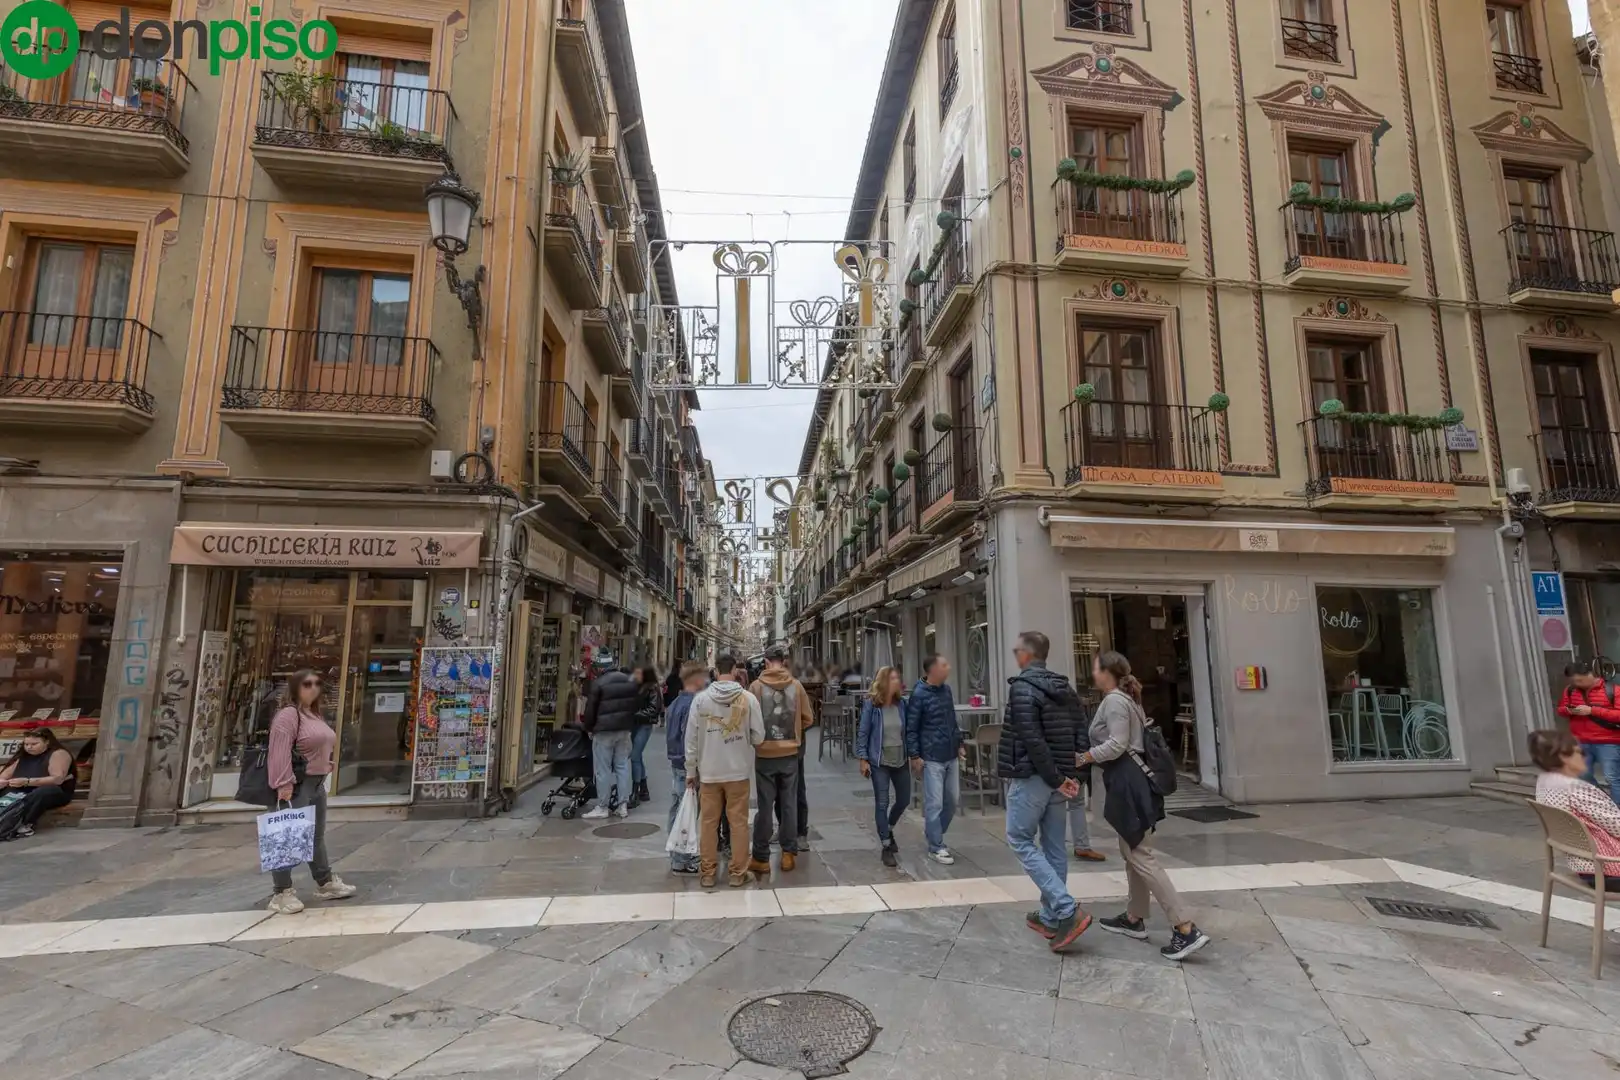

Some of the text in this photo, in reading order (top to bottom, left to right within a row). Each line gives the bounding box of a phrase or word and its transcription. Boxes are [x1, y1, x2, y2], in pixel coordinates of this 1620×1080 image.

[1080, 239, 1186, 256] CASA CATEDRAL
[1100, 470, 1217, 485] CASA CATEDRAL
[201, 533, 398, 558] CUCHILLERÍA RUIZ
[1537, 576, 1556, 593] AT
[1224, 573, 1308, 615] Rollo
[1320, 606, 1363, 629] Rollo
[267, 812, 306, 825] FRIKING
